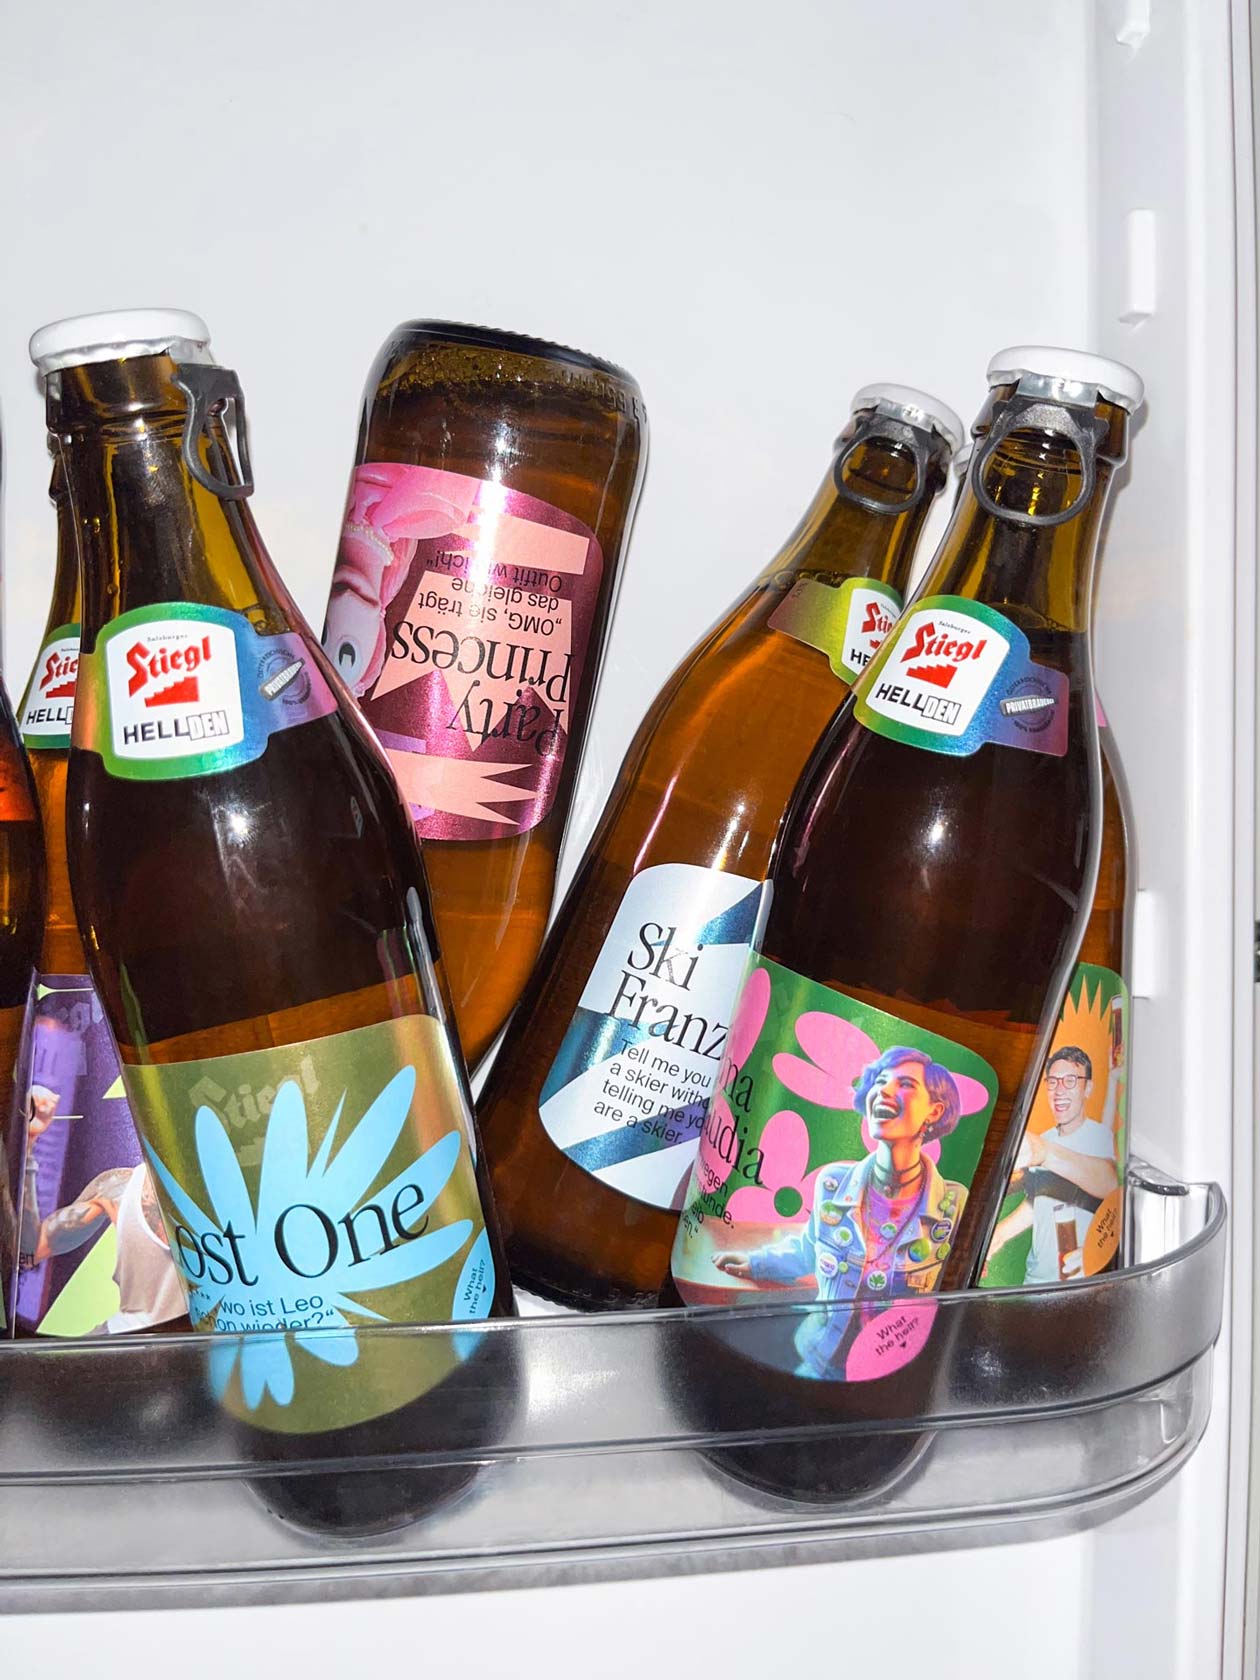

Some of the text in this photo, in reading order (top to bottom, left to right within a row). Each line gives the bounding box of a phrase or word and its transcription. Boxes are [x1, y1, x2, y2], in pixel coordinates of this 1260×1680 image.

[512, 567, 562, 593] Outfit
[419, 591, 463, 618] trägt
[469, 603, 498, 623] sie
[528, 593, 560, 613] das
[900, 622, 987, 663] Stiegl
[39, 652, 79, 690] Stie
[126, 636, 211, 698] Stiegl
[391, 621, 575, 703] Princess
[26, 706, 73, 725] HELL
[446, 680, 564, 756] Party
[876, 683, 962, 725] HELLDEN
[123, 710, 230, 745] HELLDEN
[627, 922, 704, 991] Ski
[605, 970, 730, 1061] Franz
[610, 1062, 622, 1076] a
[625, 1068, 669, 1094] skier
[620, 1038, 712, 1088] Tell me you
[602, 1079, 655, 1115] telling
[658, 1104, 685, 1122] me
[594, 1100, 683, 1145] are a skier.
[175, 1183, 430, 1287] ost One
[464, 1267, 478, 1301] What
[220, 1295, 323, 1317] wo ist Leo
[469, 1293, 480, 1314] the
[876, 1316, 906, 1340] What
[875, 1340, 895, 1356] the
